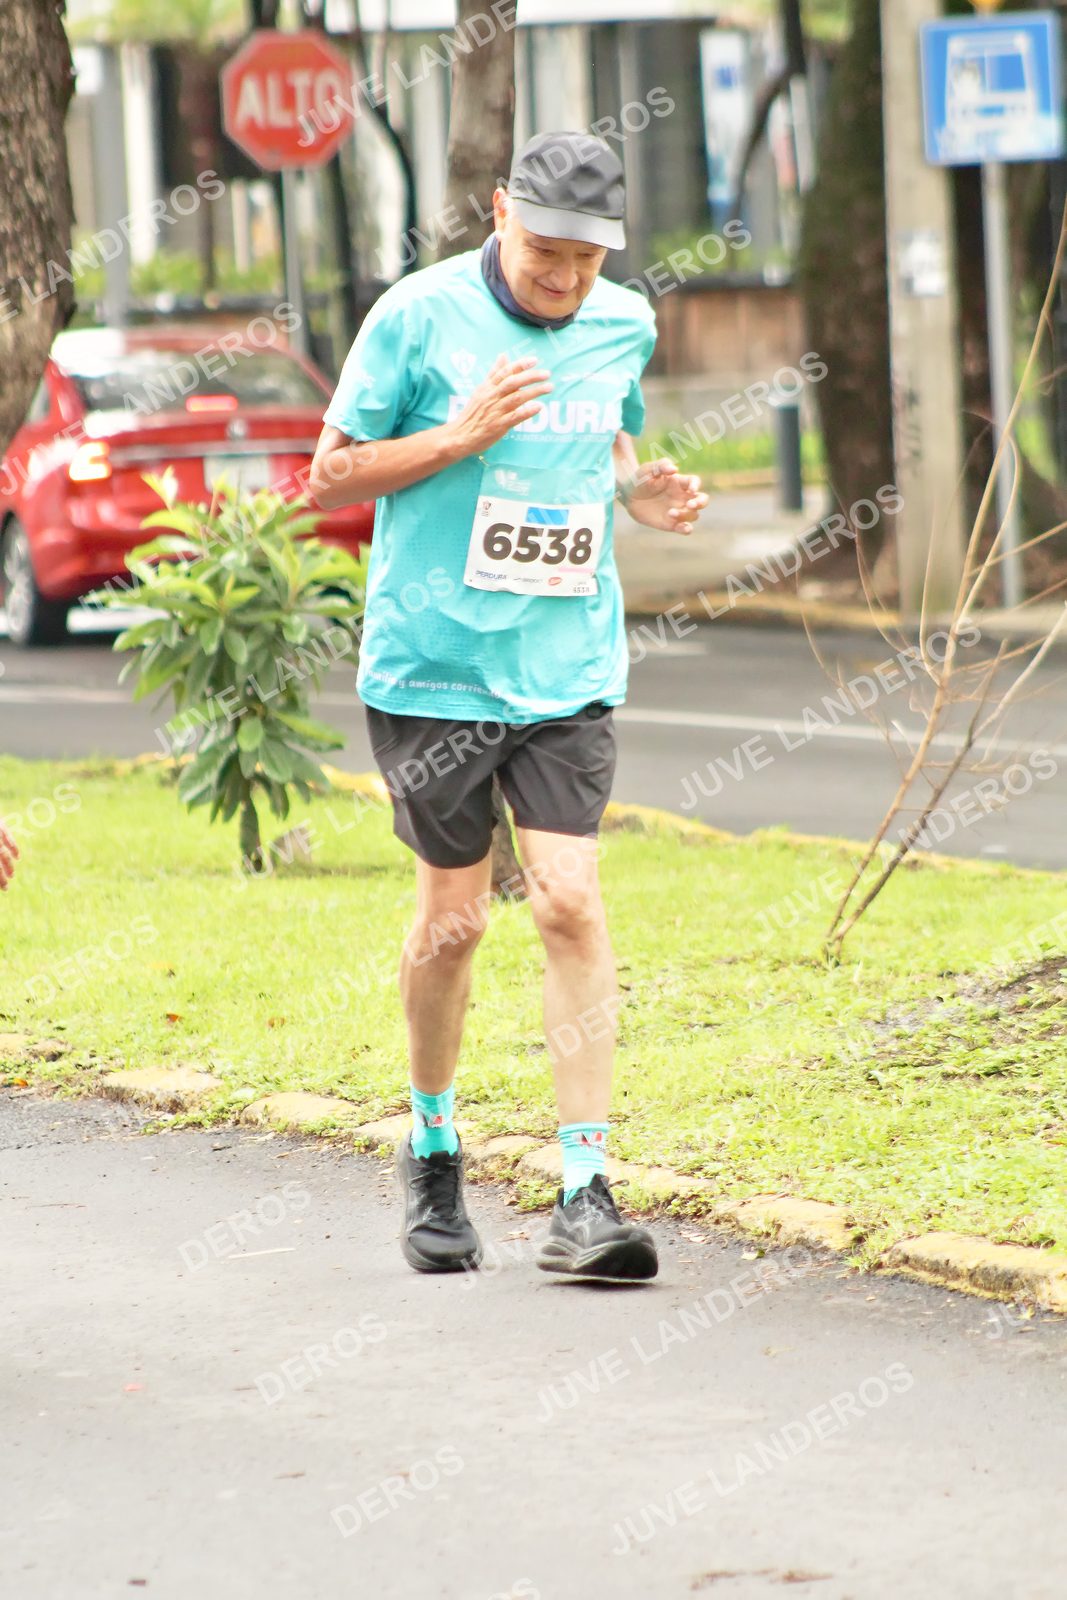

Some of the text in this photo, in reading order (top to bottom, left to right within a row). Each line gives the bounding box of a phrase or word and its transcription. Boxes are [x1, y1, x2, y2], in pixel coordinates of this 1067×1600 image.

[235, 69, 342, 130] ALTO
[448, 393, 623, 434] PDURA
[483, 522, 593, 565] 6538
[409, 679, 449, 692] amigos
